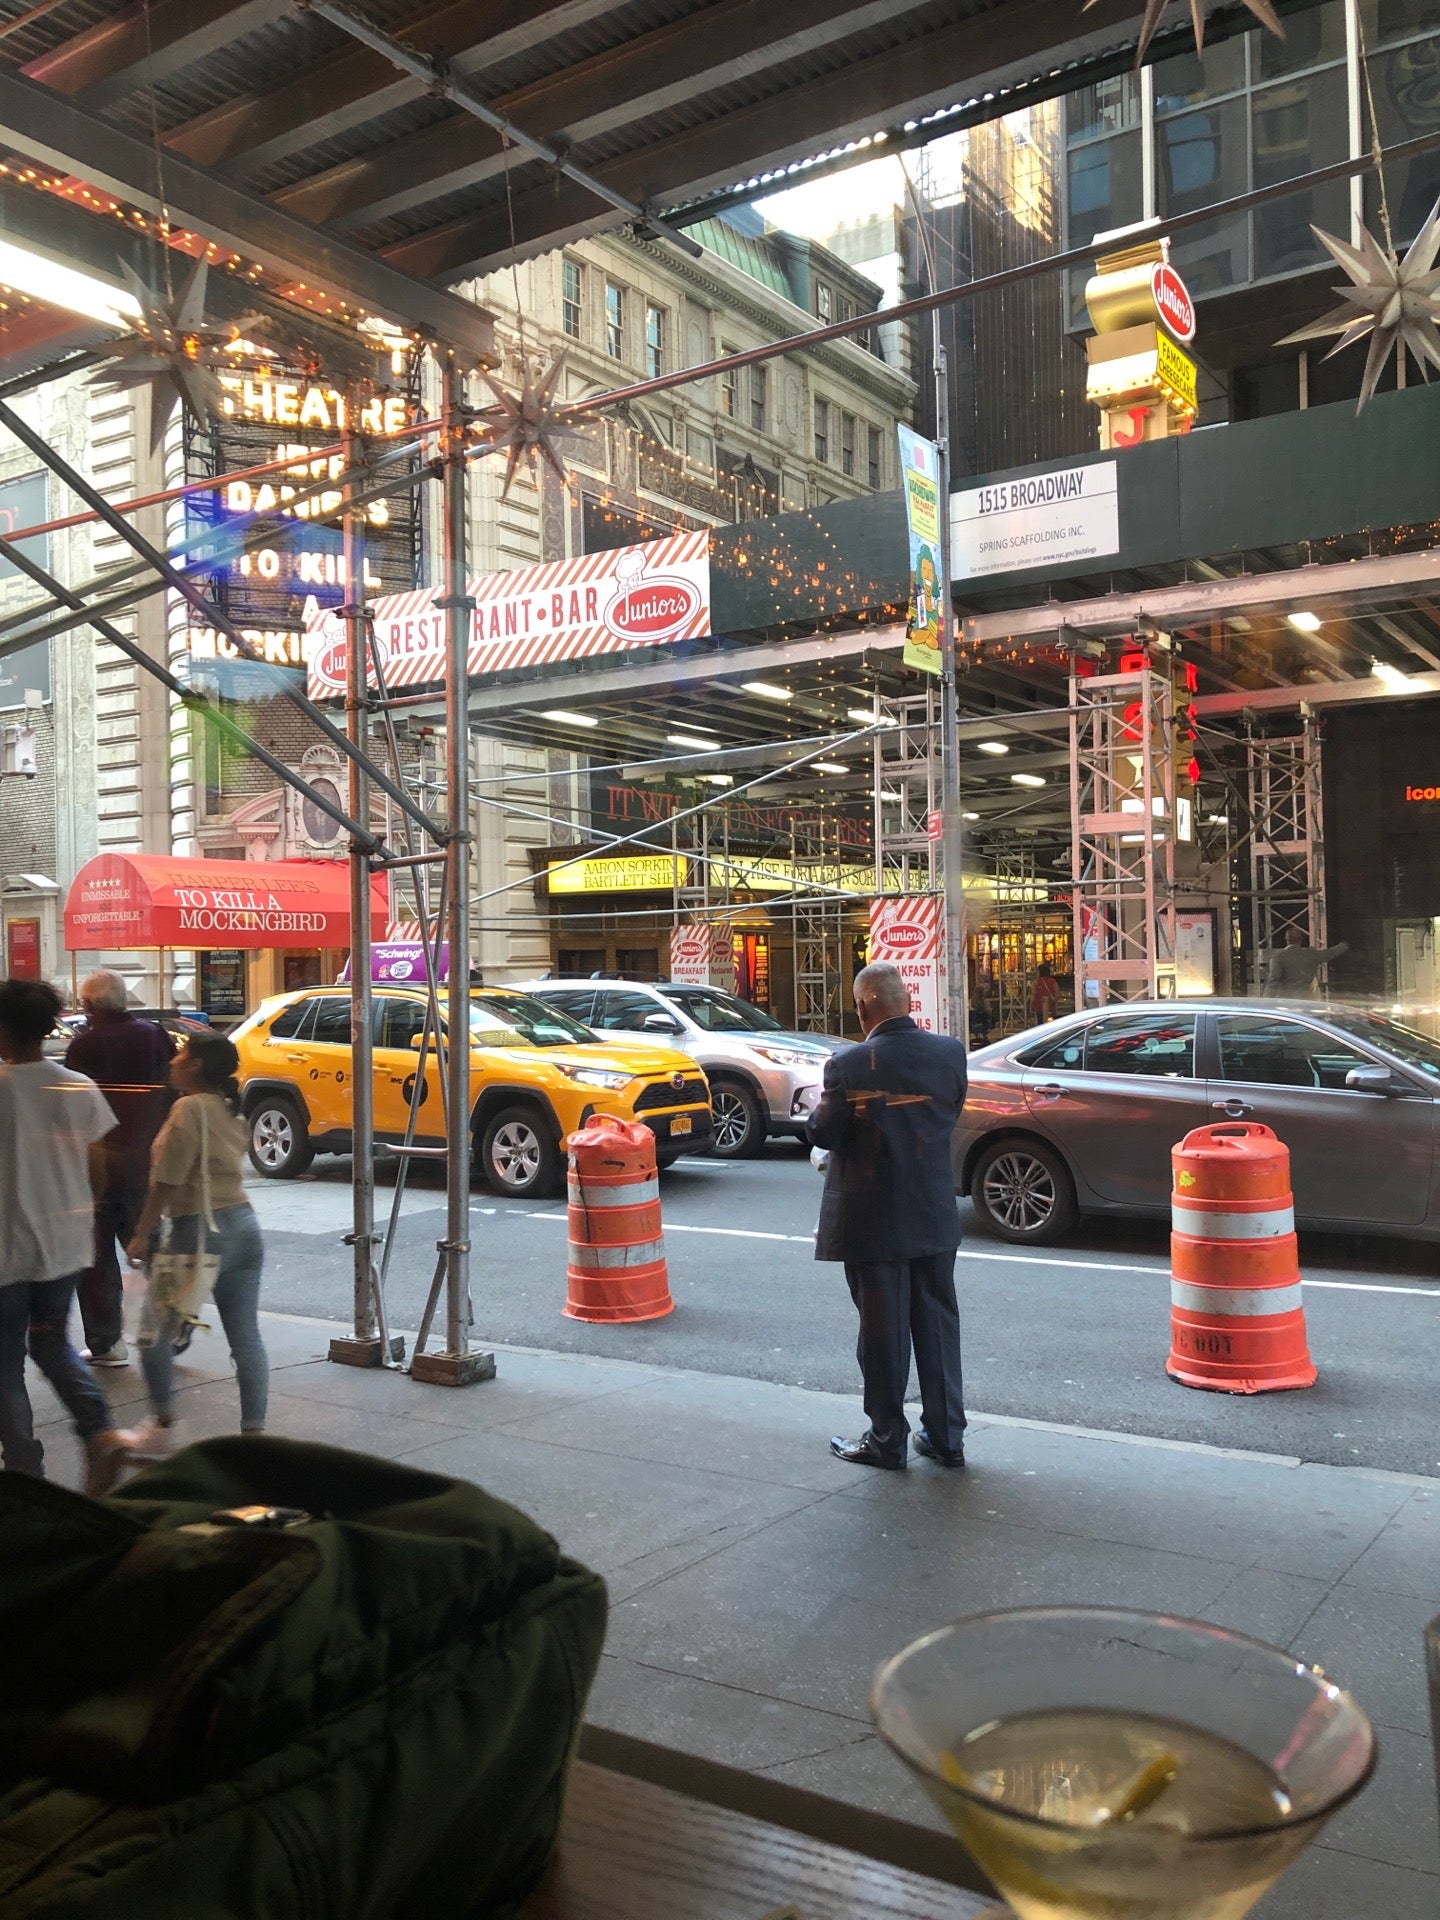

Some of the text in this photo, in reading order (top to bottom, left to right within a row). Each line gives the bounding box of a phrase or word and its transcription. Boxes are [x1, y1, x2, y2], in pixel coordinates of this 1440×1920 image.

[1156, 264, 1191, 329] Junior's
[1161, 342, 1191, 381] FAMOUS
[1158, 357, 1194, 400] CHEESECAKE
[227, 480, 390, 527] DANIES
[978, 470, 1085, 514] 1515 BROADWAY
[979, 525, 1086, 554] SPRING SCAFFOLDING INC.
[617, 585, 689, 628] Junior's
[390, 586, 598, 656] RESTRANT BAR
[584, 858, 675, 875] AARON SORKIN
[168, 873, 320, 894] HARPER LEE'S
[584, 872, 646, 888] BARTLETT
[81, 888, 130, 902] UNMISSABLE
[173, 889, 283, 911] TO KILL A
[178, 908, 327, 931] MOCKINGBIRD
[883, 922, 925, 943] Junior's
[673, 967, 706, 975] BREAKFAST
